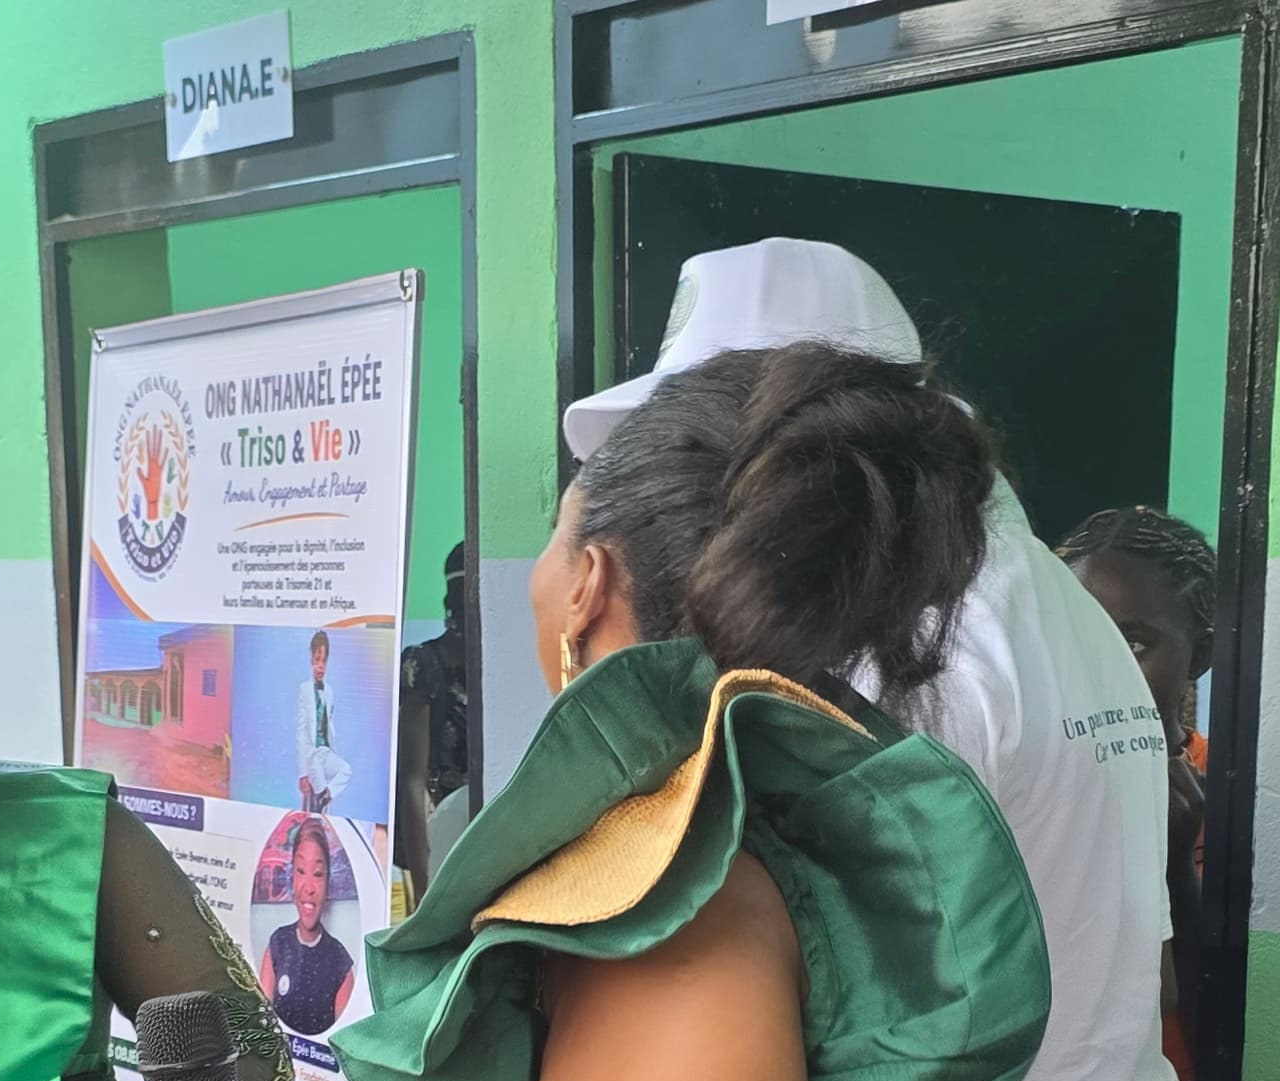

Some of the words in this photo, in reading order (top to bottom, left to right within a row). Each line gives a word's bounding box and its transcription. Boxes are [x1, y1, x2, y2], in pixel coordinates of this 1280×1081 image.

[182, 57, 274, 115] DIANA.E
[205, 380, 237, 419] ONG
[241, 359, 336, 415] NATHANAËL
[341, 353, 382, 403] ÉPÉE
[237, 425, 286, 468] Triso
[292, 429, 304, 464] &
[310, 419, 342, 462] Vie
[1062, 717, 1087, 740] Un
